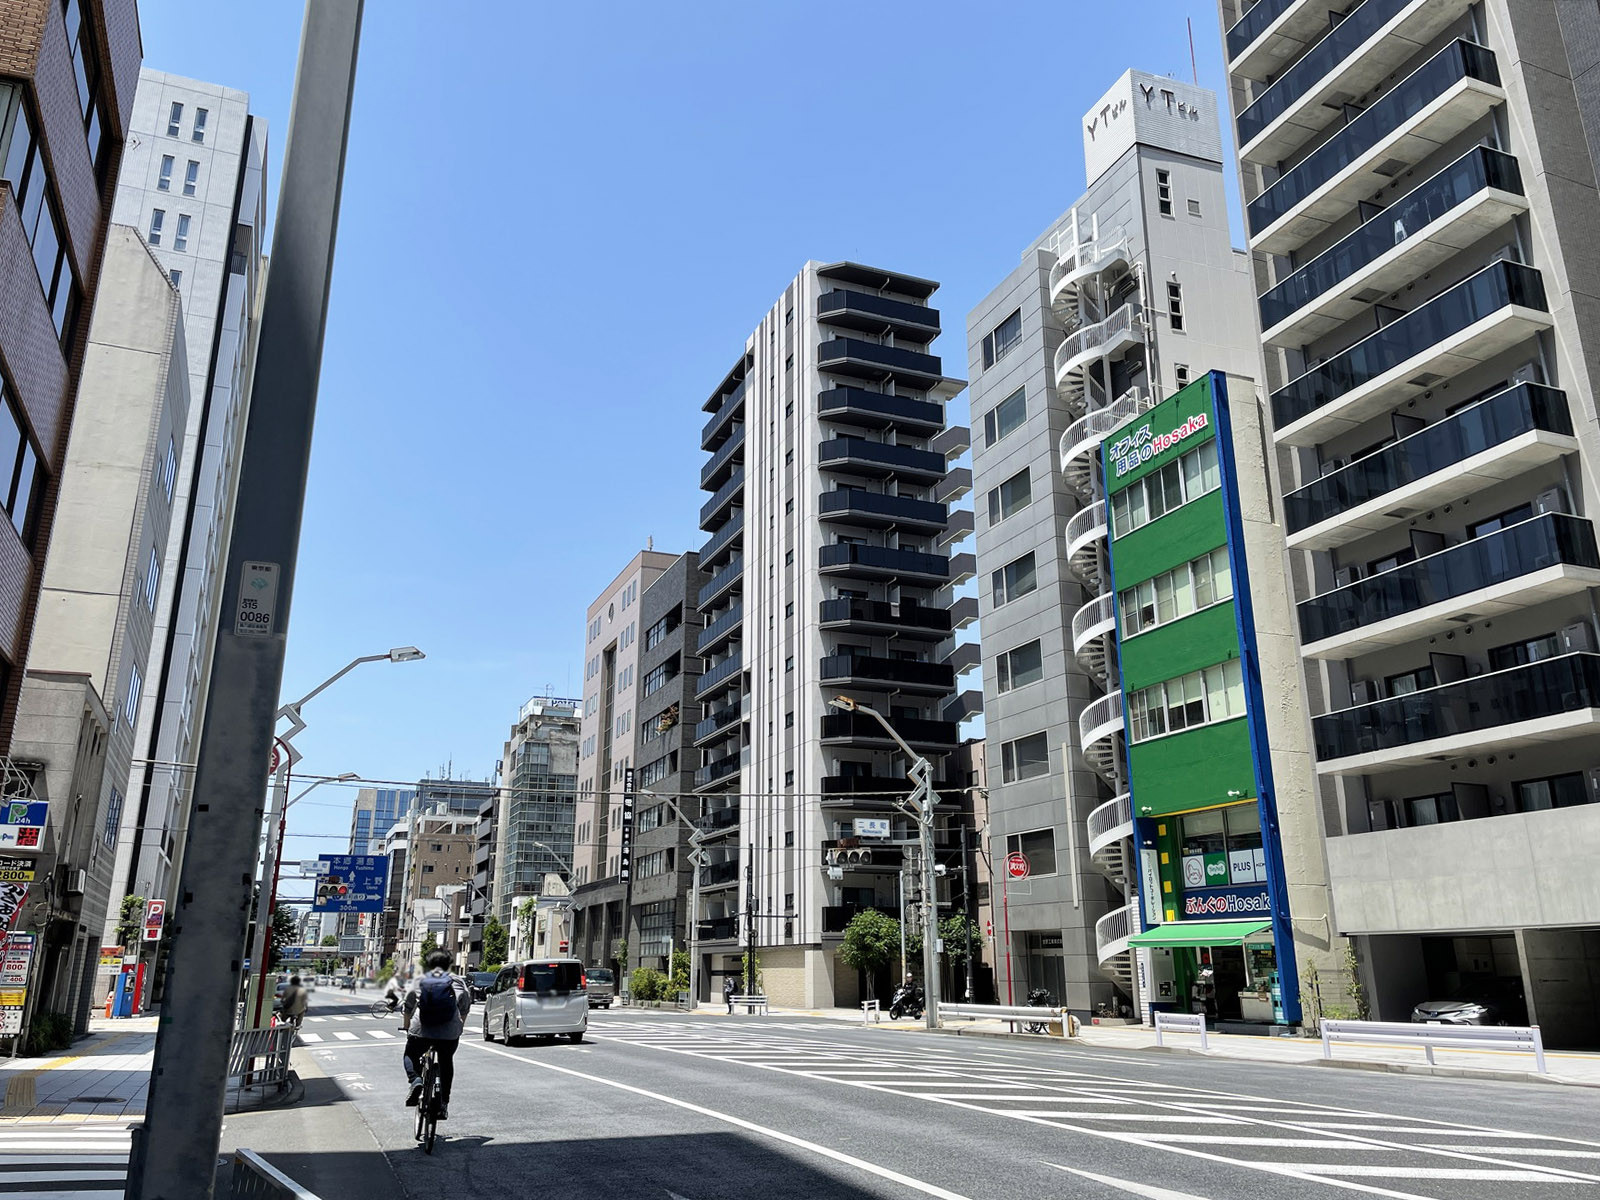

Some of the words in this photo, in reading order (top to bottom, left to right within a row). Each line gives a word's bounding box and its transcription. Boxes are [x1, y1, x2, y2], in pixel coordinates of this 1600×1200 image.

[1109, 424, 1152, 462] オフィス
[241, 602, 258, 610] 315
[240, 611, 270, 624] 0086
[1233, 861, 1252, 872] PLUS
[363, 877, 383, 886] 上野
[148, 904, 162, 919] P
